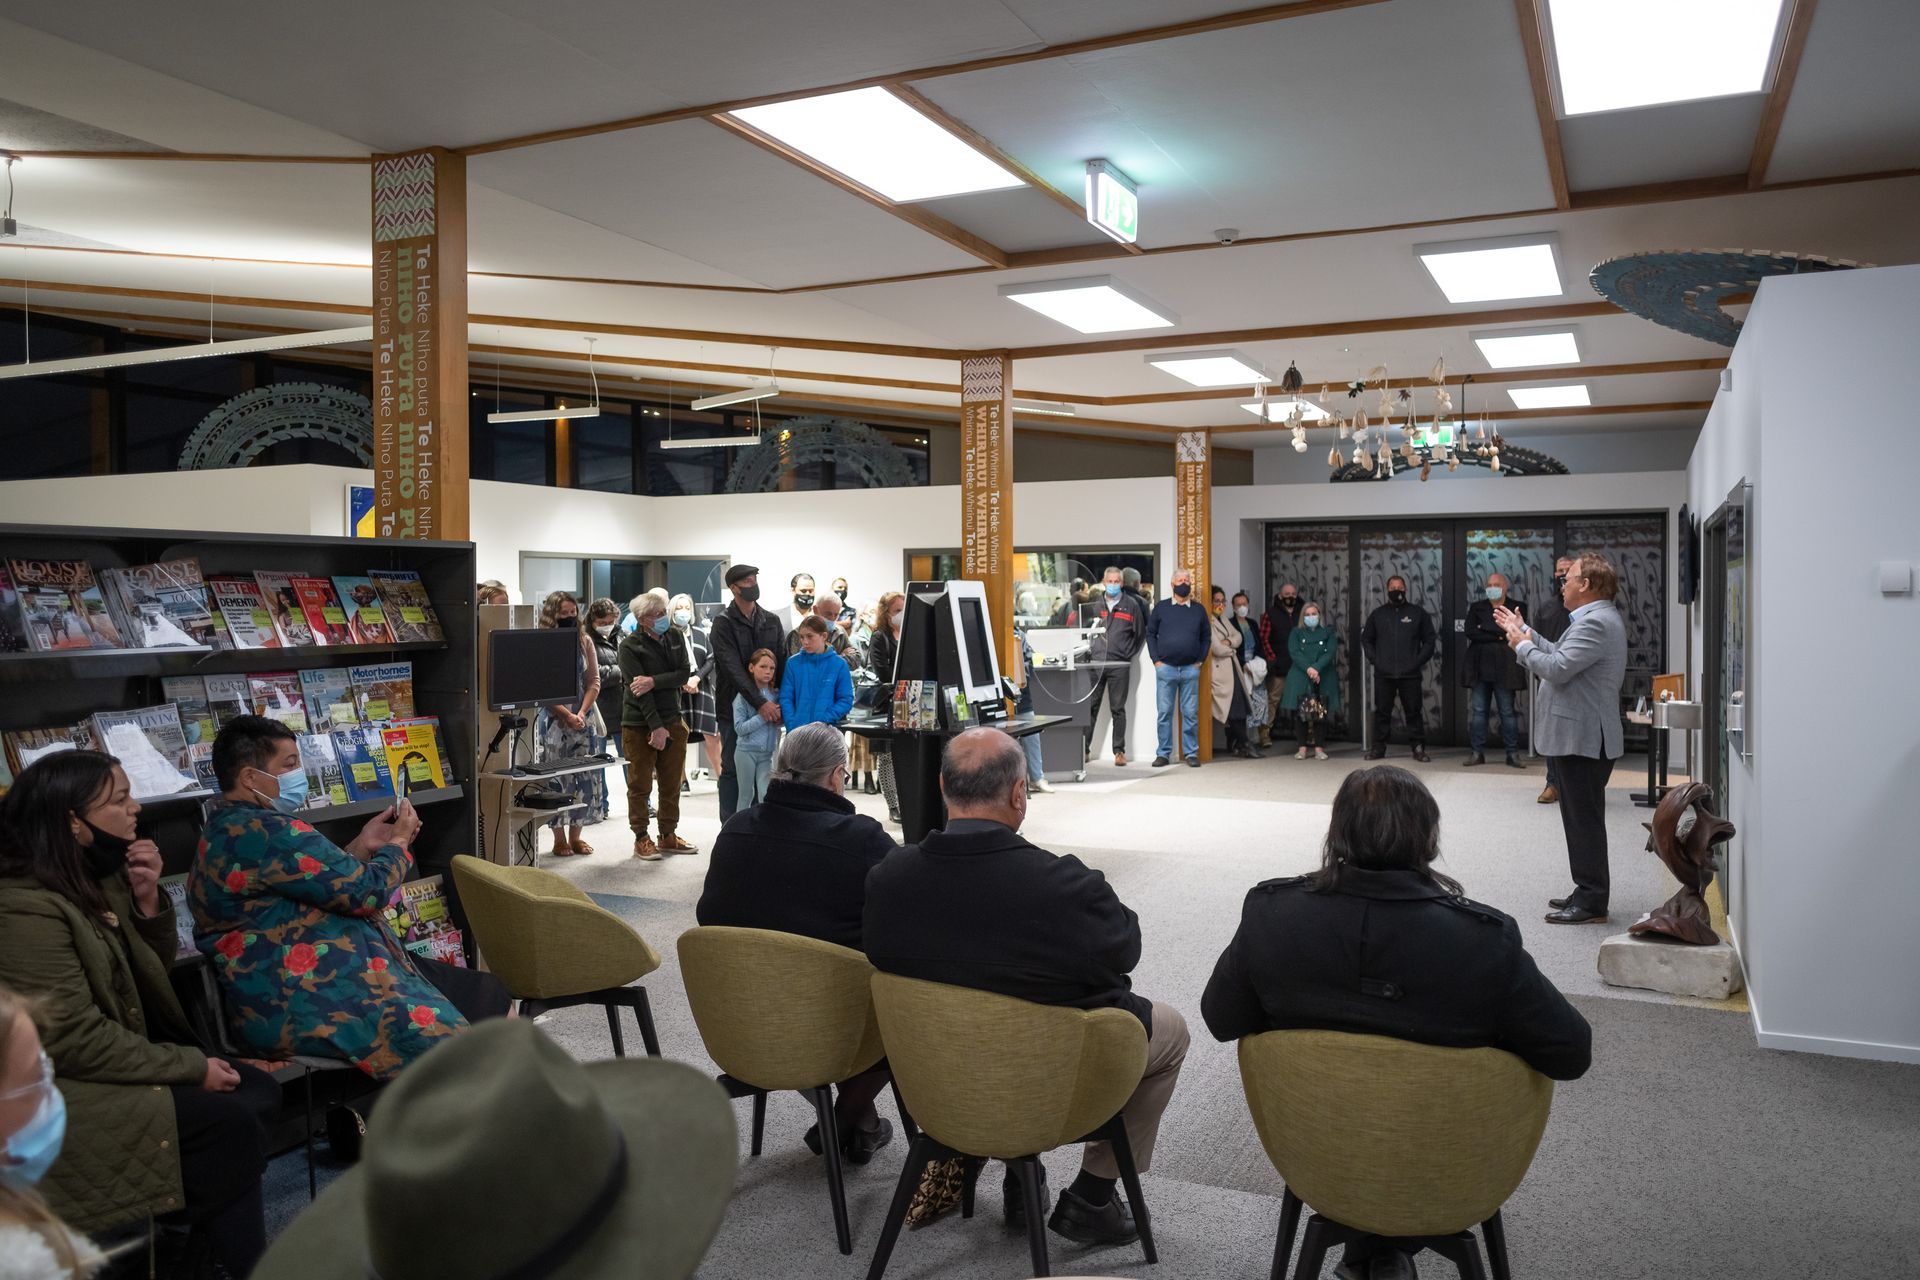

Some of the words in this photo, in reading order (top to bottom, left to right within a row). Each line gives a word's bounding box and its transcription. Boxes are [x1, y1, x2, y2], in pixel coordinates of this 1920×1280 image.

[417, 244, 431, 269] Te
[380, 249, 392, 291] Niho
[417, 275, 431, 324] Heke
[380, 297, 392, 335] Puta
[380, 338, 394, 364] Te
[418, 330, 431, 371] Niho
[381, 370, 394, 417] Heke
[415, 377, 429, 416] puta
[990, 405, 999, 418] Te
[418, 421, 432, 446] Te
[966, 406, 975, 445] Whirinui
[990, 421, 999, 446] Heke
[381, 423, 394, 464] Niho
[967, 448, 976, 461] Te
[418, 452, 433, 500] Heke
[967, 464, 976, 489] Heke
[991, 449, 999, 488] Whirinui
[1196, 464, 1203, 474] Te
[382, 469, 394, 507] Puta
[991, 491, 1000, 504] Te
[966, 491, 975, 530] Whirinui
[991, 506, 1000, 532] Heke
[1179, 505, 1186, 515] Te
[382, 512, 396, 537] Te
[967, 532, 976, 545] Te
[1197, 534, 1203, 544] Te
[967, 548, 976, 574] Heke
[991, 534, 999, 574] Whirinui
[11, 560, 90, 577] HOUSE
[37, 575, 94, 585] GARDEN
[214, 582, 262, 595] LISTEN
[220, 598, 260, 607] DEMENTIA
[302, 671, 325, 684] Life
[351, 665, 410, 679] Motorhomes
[381, 674, 411, 682] Destinations
[209, 680, 246, 692] GARD
[136, 711, 178, 728] LIVING
